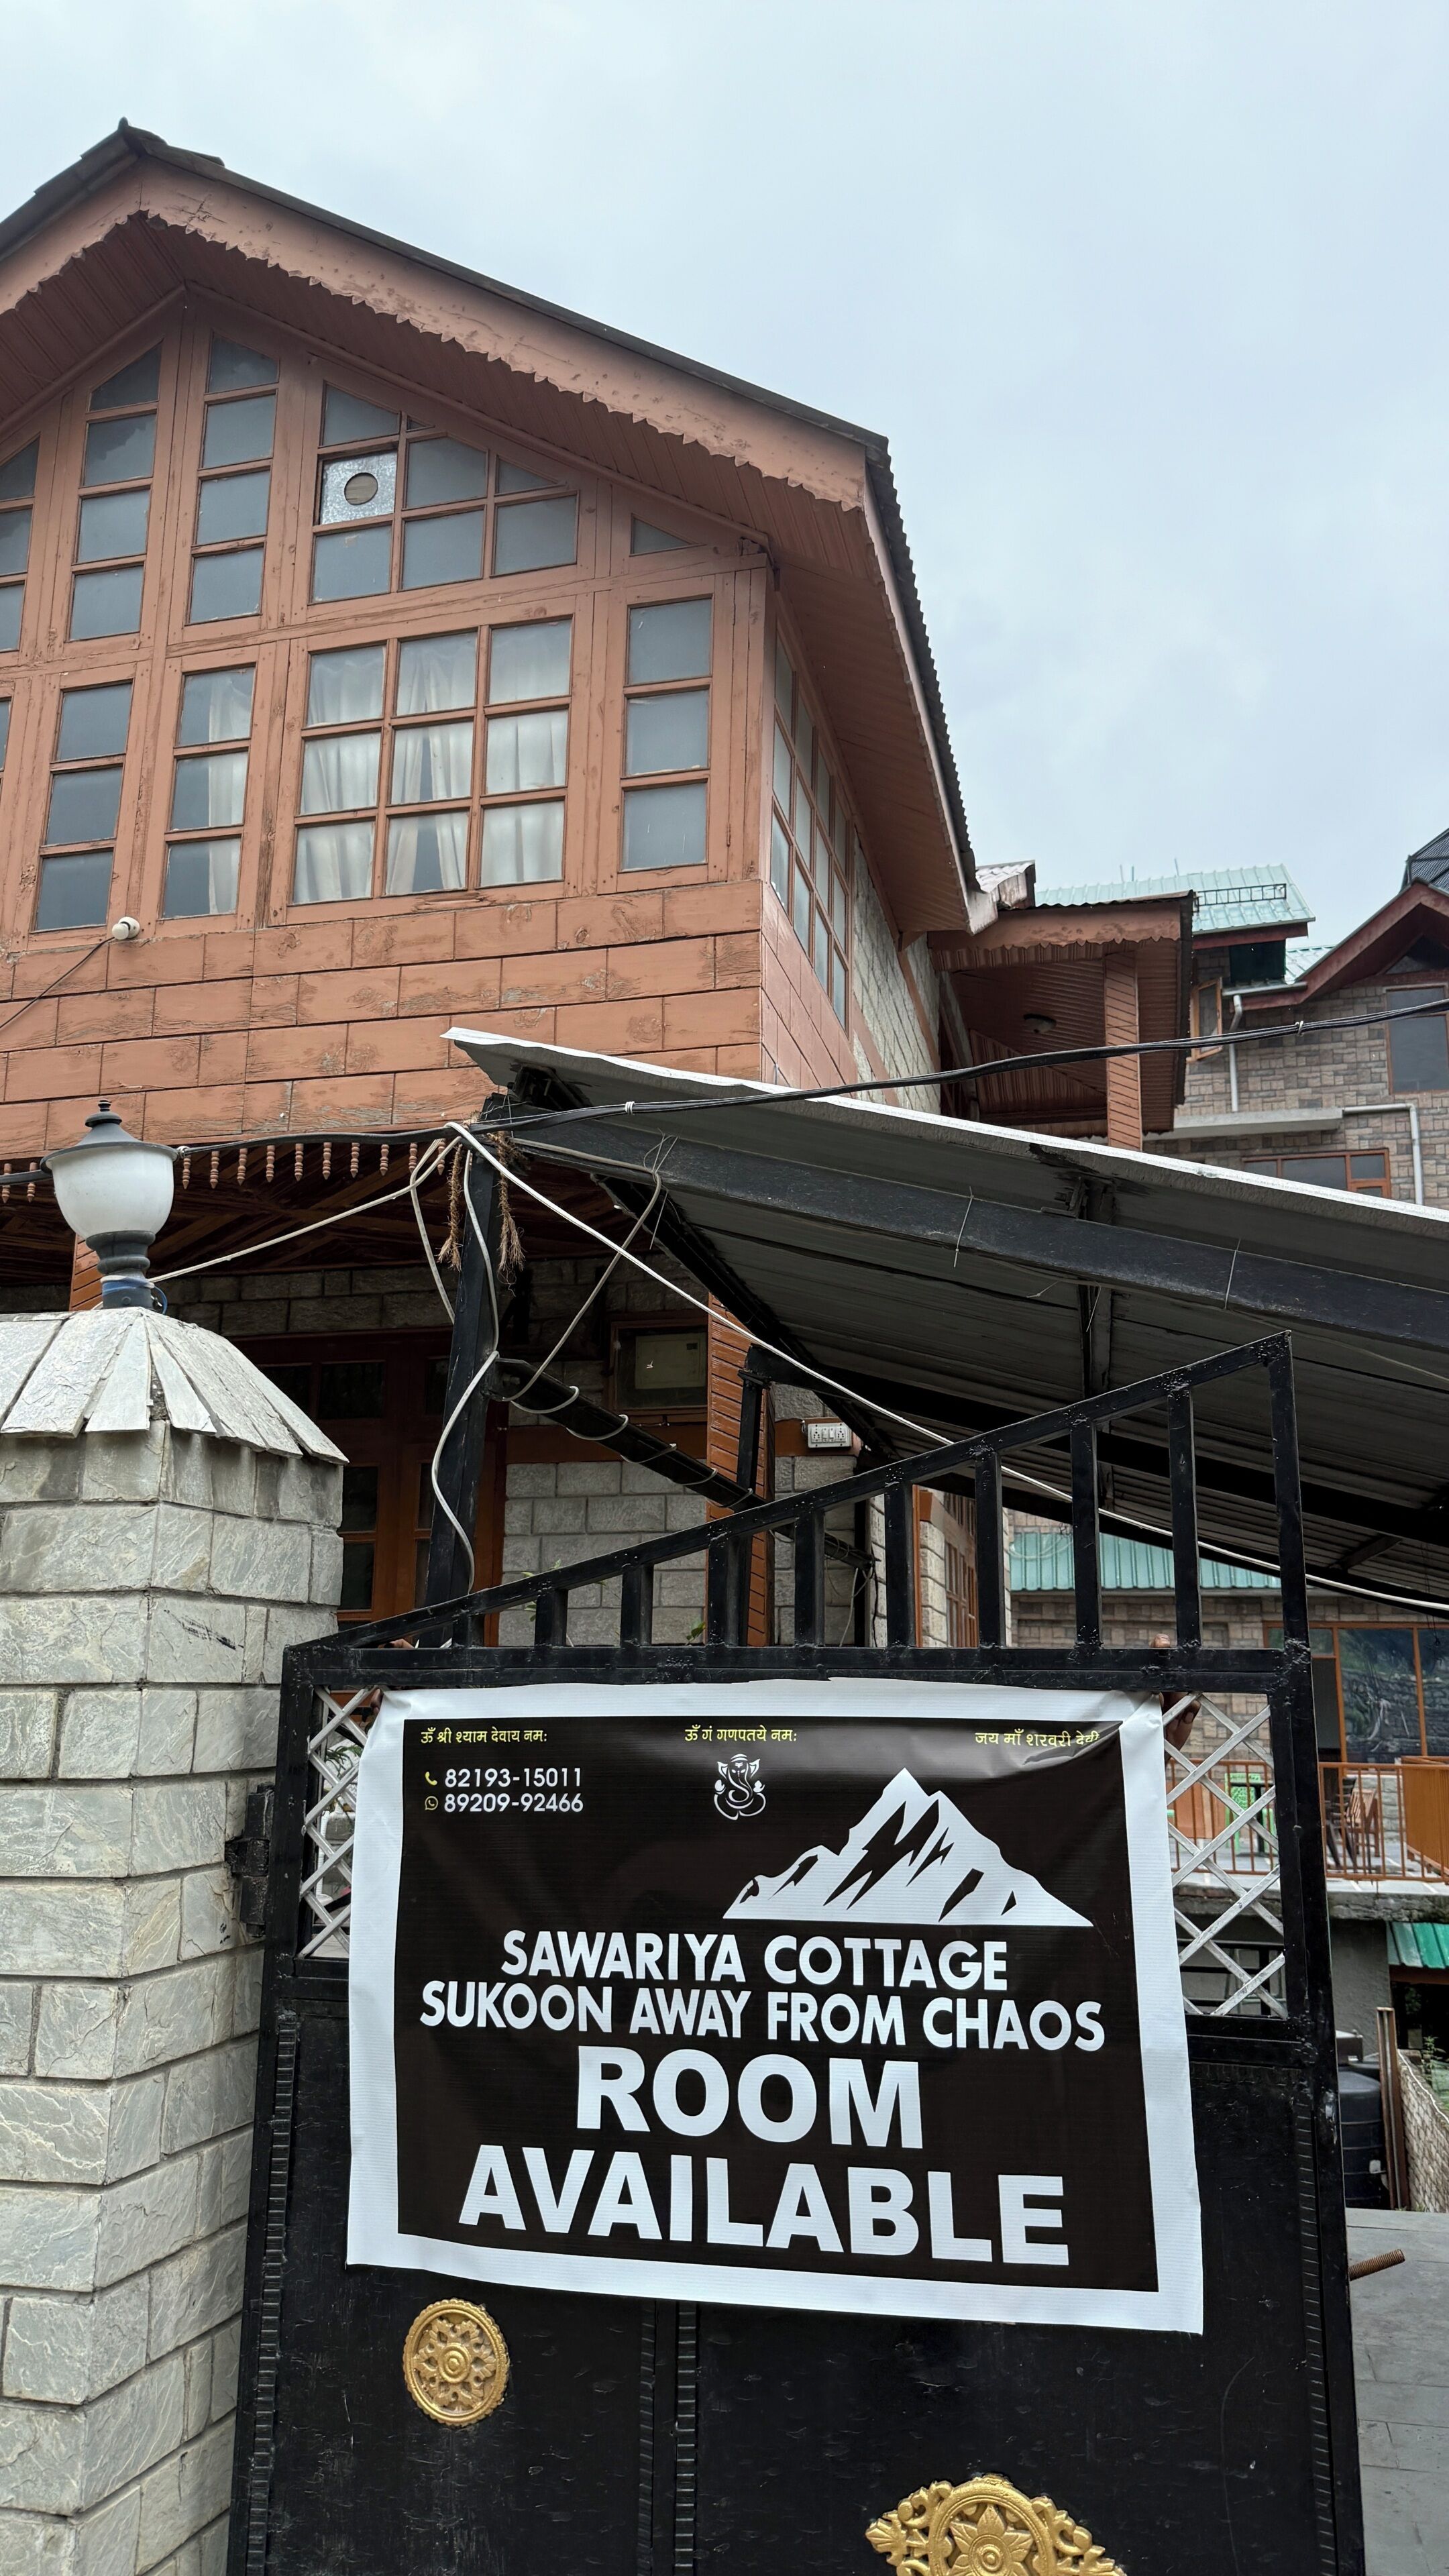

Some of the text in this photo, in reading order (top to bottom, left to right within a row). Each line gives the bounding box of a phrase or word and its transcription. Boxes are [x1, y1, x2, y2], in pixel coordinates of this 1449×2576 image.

[437, 1727, 452, 1743] श्री
[455, 1731, 488, 1743] श्याम
[491, 1726, 521, 1743] देवाय
[702, 1725, 713, 1741] गं
[716, 1725, 767, 1741] गणपतये
[975, 1731, 999, 1745] जय
[1004, 1728, 1024, 1746] माँ
[444, 1768, 581, 1788] 82193-15011
[444, 1792, 584, 1813] 89209-92466
[501, 1929, 1008, 1991] SAWARIYA COTTAGE
[420, 1980, 1105, 2051] SUKOON AWAY FROM CHAOS
[577, 2045, 923, 2149] ROOM
[458, 2144, 1069, 2265] AVAILABLE
